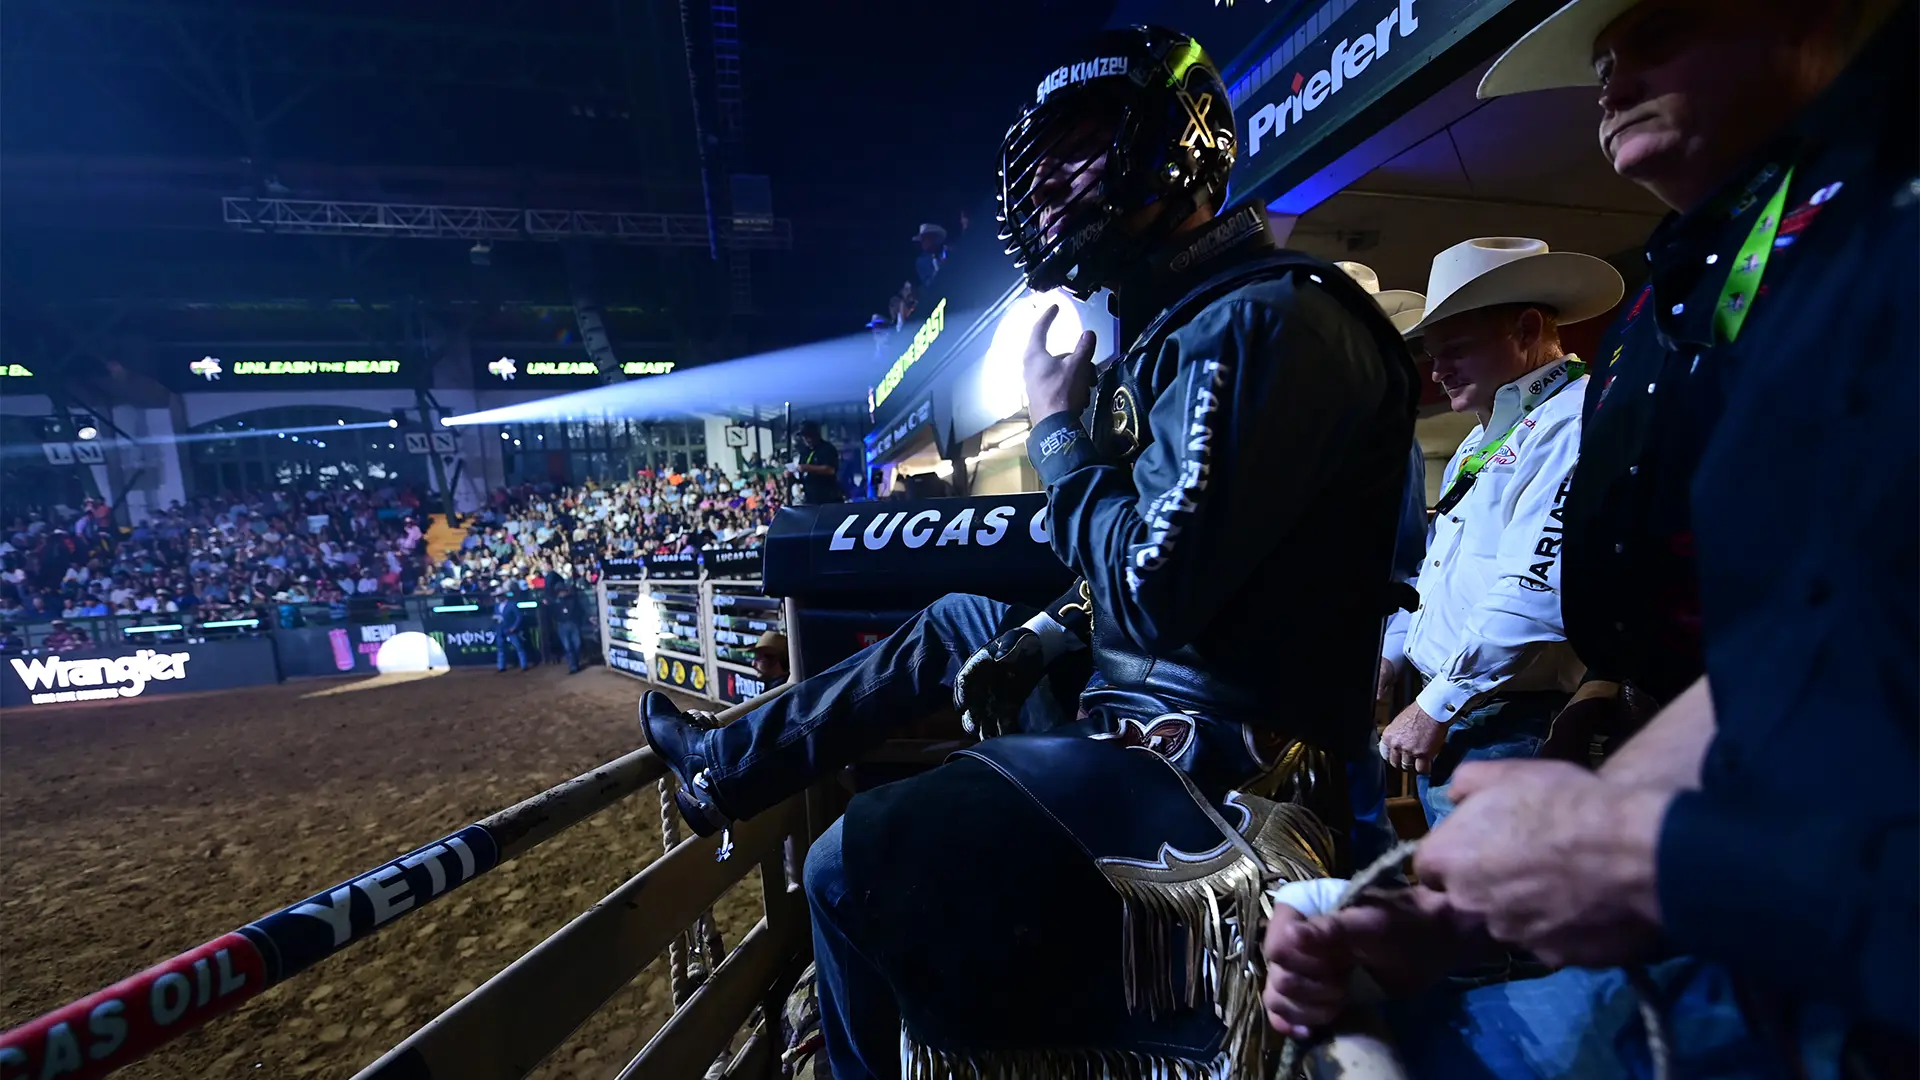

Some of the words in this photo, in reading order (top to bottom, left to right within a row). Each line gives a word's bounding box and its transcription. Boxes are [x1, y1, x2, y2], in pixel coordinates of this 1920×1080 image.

[1249, 0, 1418, 157] Priefert
[234, 361, 317, 374] UNLEASH
[318, 362, 345, 373] THE
[345, 360, 400, 374] BEAST
[624, 362, 674, 374] BEAST
[1543, 361, 1568, 388] ARI
[829, 505, 1016, 551] LUCAS
[1529, 476, 1571, 581] ARIAT
[652, 554, 678, 563] LUCAS
[679, 553, 693, 562] OIL
[716, 552, 744, 562] LUCAS
[745, 551, 759, 560] OIL
[361, 624, 396, 642] NEW!
[10, 649, 190, 697] Wrangler
[289, 837, 476, 947] YETI
[150, 948, 247, 1026] OIL
